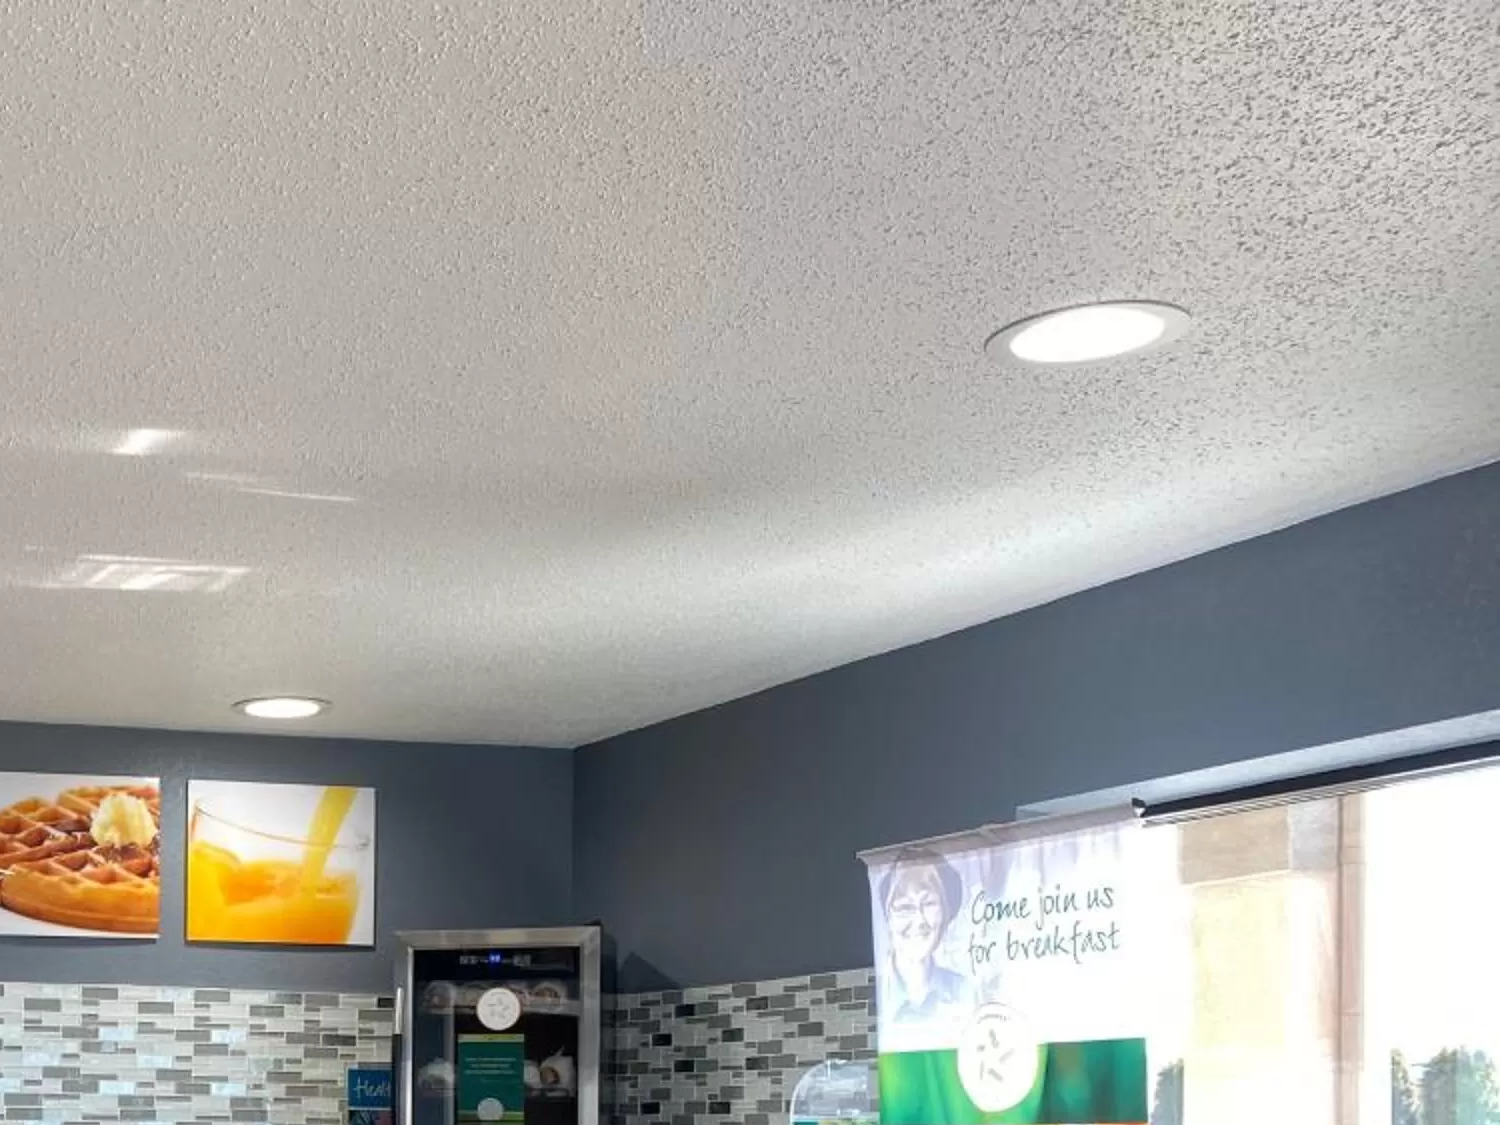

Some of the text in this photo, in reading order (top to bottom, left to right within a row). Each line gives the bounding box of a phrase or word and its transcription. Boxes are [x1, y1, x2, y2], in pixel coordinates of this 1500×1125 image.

[971, 883, 1115, 933] Come join us
[968, 920, 1121, 976] for breakfast
